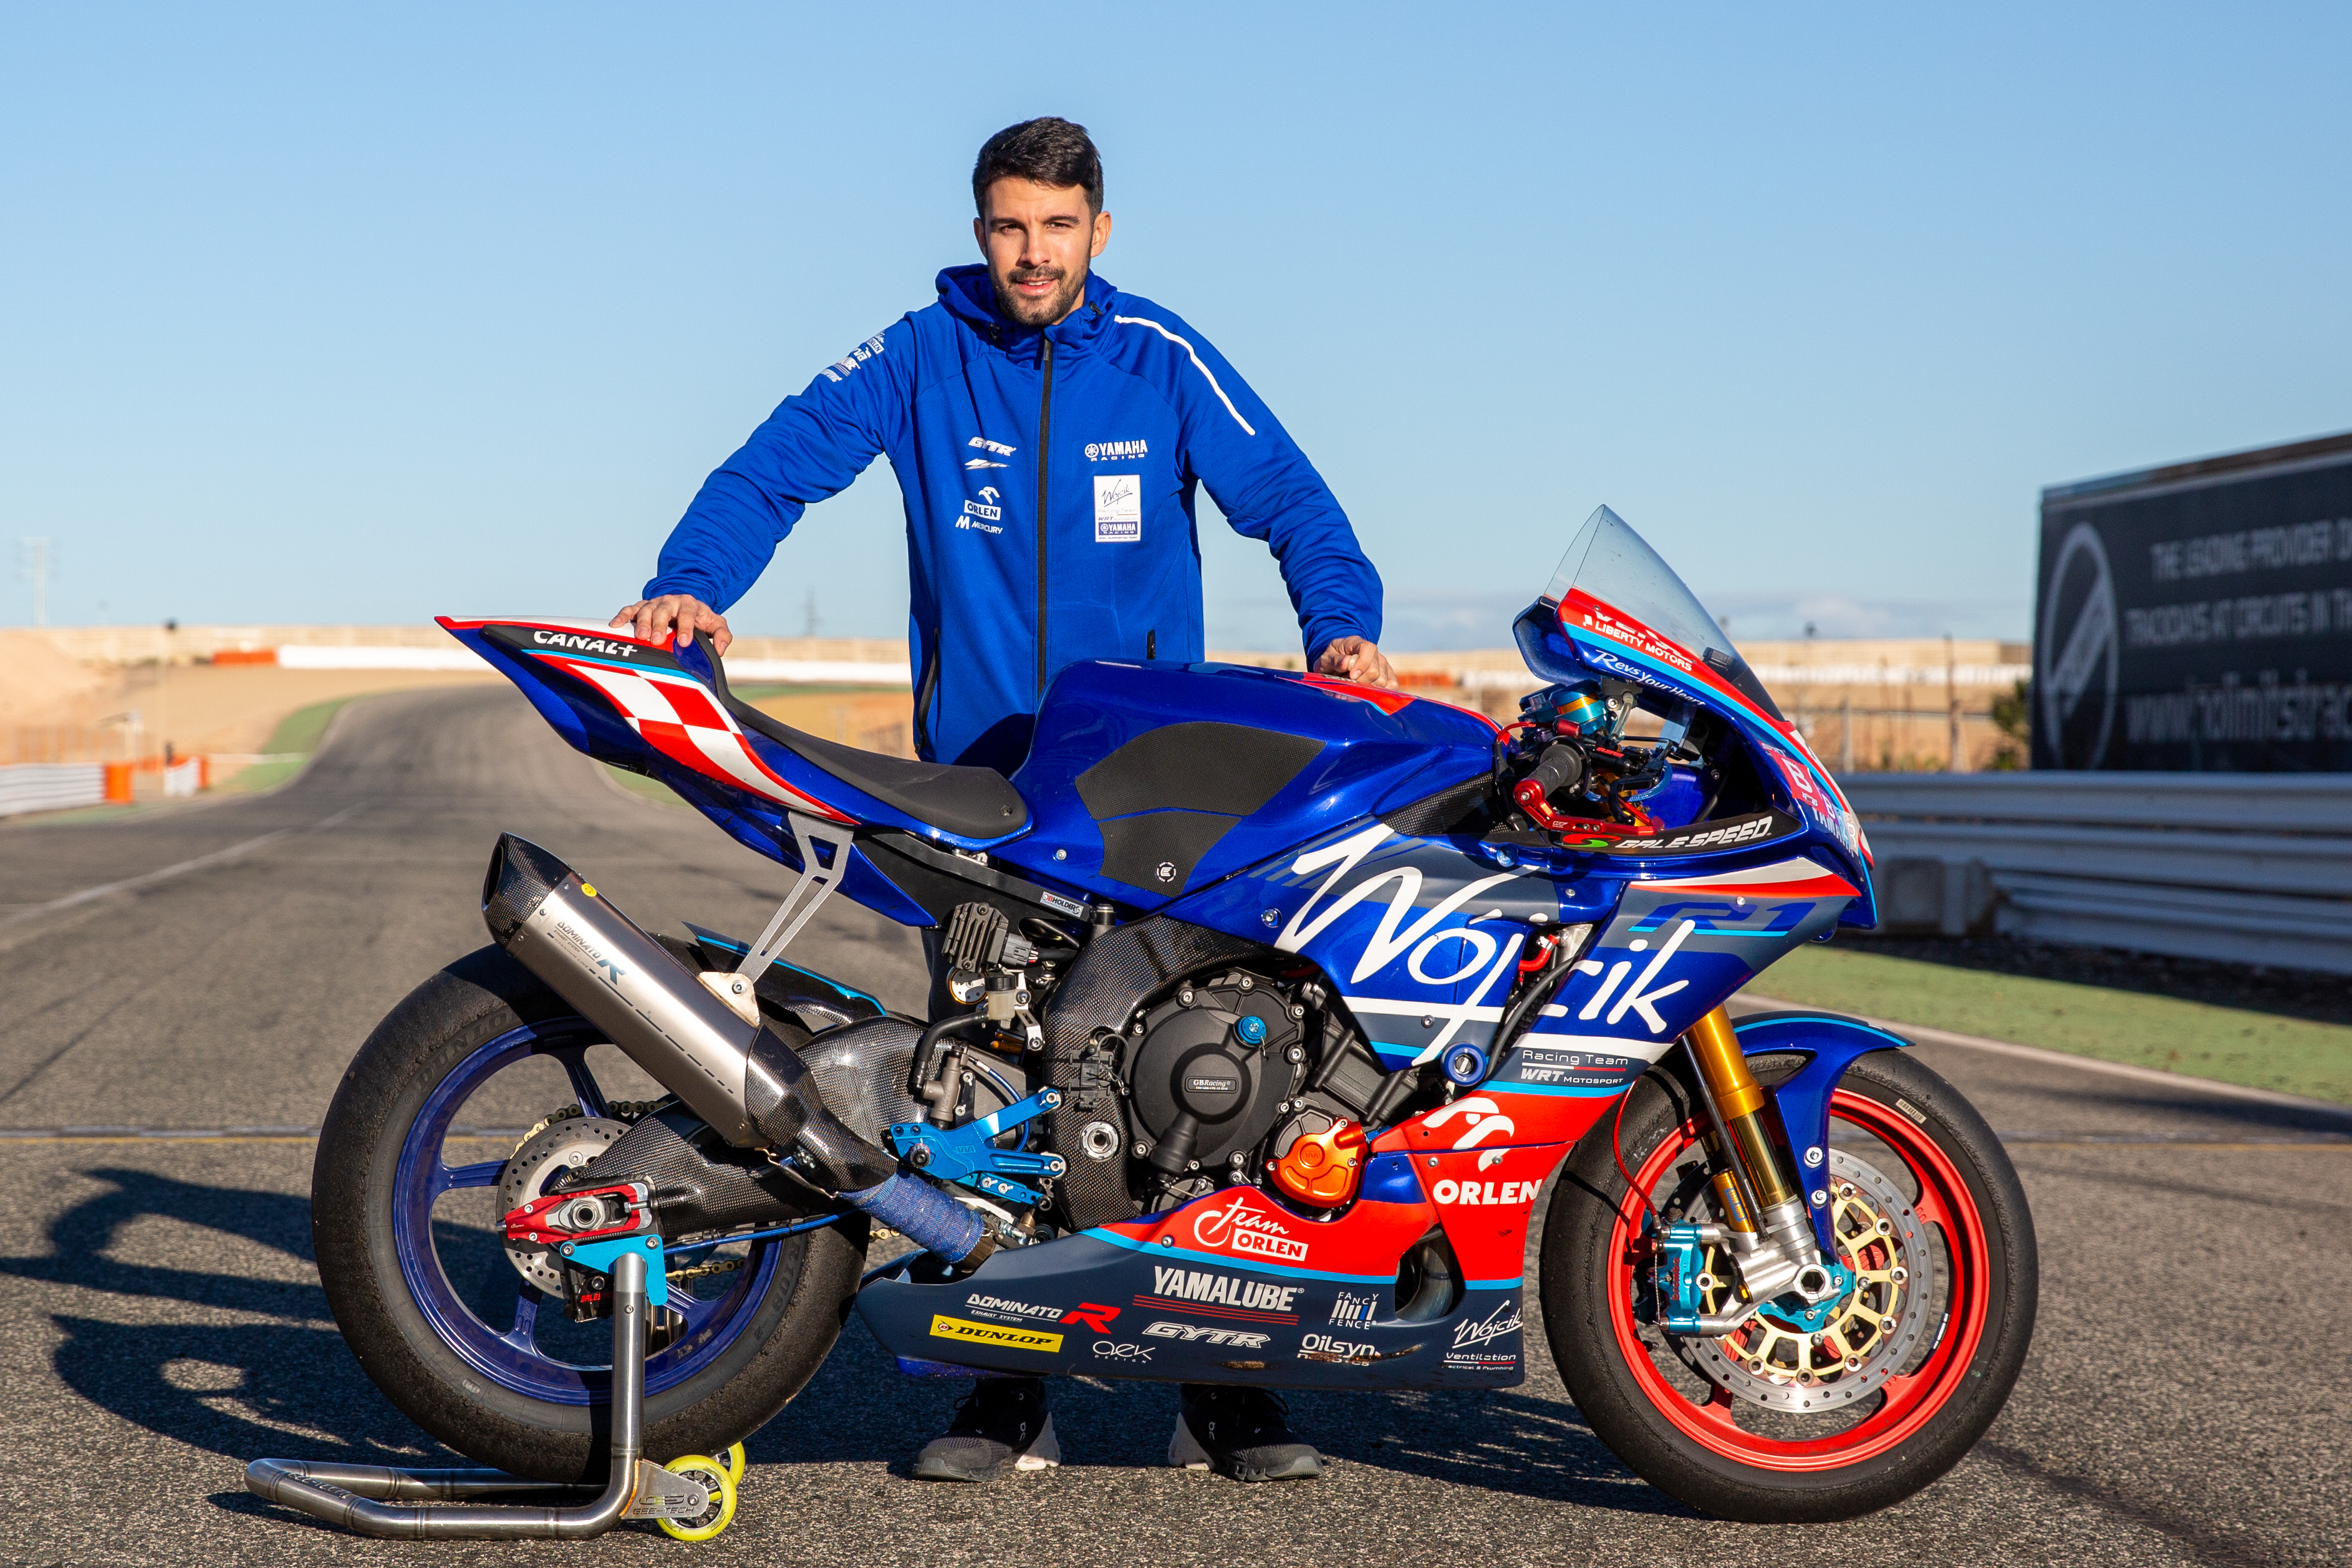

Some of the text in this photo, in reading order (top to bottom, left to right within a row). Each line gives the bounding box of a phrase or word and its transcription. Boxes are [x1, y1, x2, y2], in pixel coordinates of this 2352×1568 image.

[968, 436, 1011, 456] GYTR
[1099, 439, 1148, 456] YAMAHA
[1091, 453, 1145, 462] RACING
[967, 503, 998, 518] ORLEN
[971, 521, 1003, 534] MERCURY
[1108, 523, 1136, 531] YAMAHA
[534, 630, 638, 657] CANAL+
[1595, 621, 1644, 647] LIBERTY
[1645, 641, 1692, 671] MOTORS
[1591, 649, 1642, 681] Revs
[1669, 686, 1707, 706] Heart
[1522, 1050, 1629, 1065] Racing Team
[1520, 1068, 1565, 1082] WRT
[1433, 1179, 1543, 1205] ORLEN
[1238, 1233, 1303, 1258] ORLEN
[1154, 1266, 1298, 1311] YAMALUBE
[1337, 1292, 1379, 1305] FANCY
[970, 1309, 1023, 1323] EXHAUST SYSTEM
[1329, 1318, 1371, 1330] FENCE
[955, 1325, 1054, 1346] DUNLOP
[1142, 1321, 1271, 1349] GYTR
[1301, 1333, 1376, 1359] Oilsyn
[1094, 1354, 1147, 1364] DESIGN
[1446, 1352, 1516, 1360] Ventilation
[632, 1506, 695, 1515] GEE-TECH
